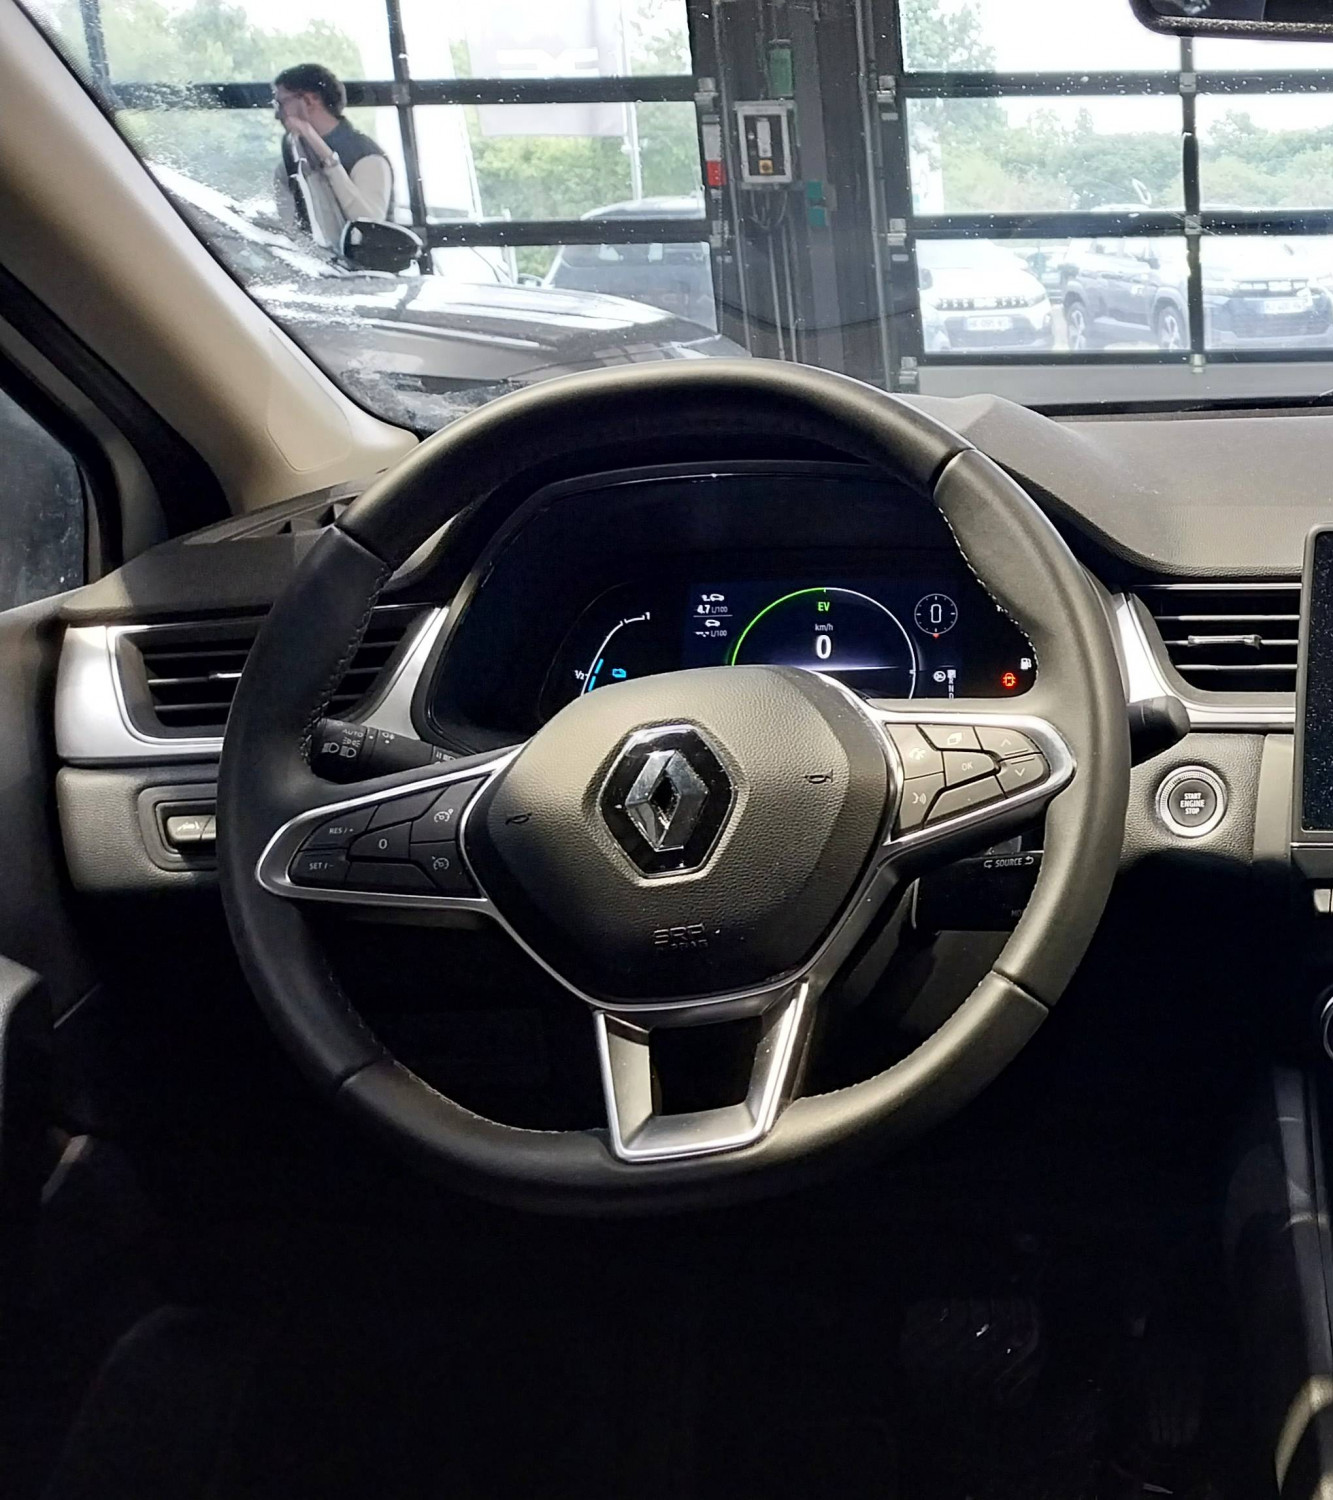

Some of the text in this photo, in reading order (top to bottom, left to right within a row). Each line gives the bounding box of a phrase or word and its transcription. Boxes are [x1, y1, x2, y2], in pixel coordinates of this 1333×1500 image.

[817, 601, 830, 611] EV
[814, 623, 834, 631] km/h
[816, 634, 832, 659] 0
[342, 729, 364, 738] AUTO
[961, 762, 973, 771] OK
[1184, 792, 1202, 800] START
[1180, 800, 1205, 808] ENGINE
[378, 838, 388, 850] 0
[309, 862, 322, 870] SET
[995, 857, 1022, 868] SOURCE
